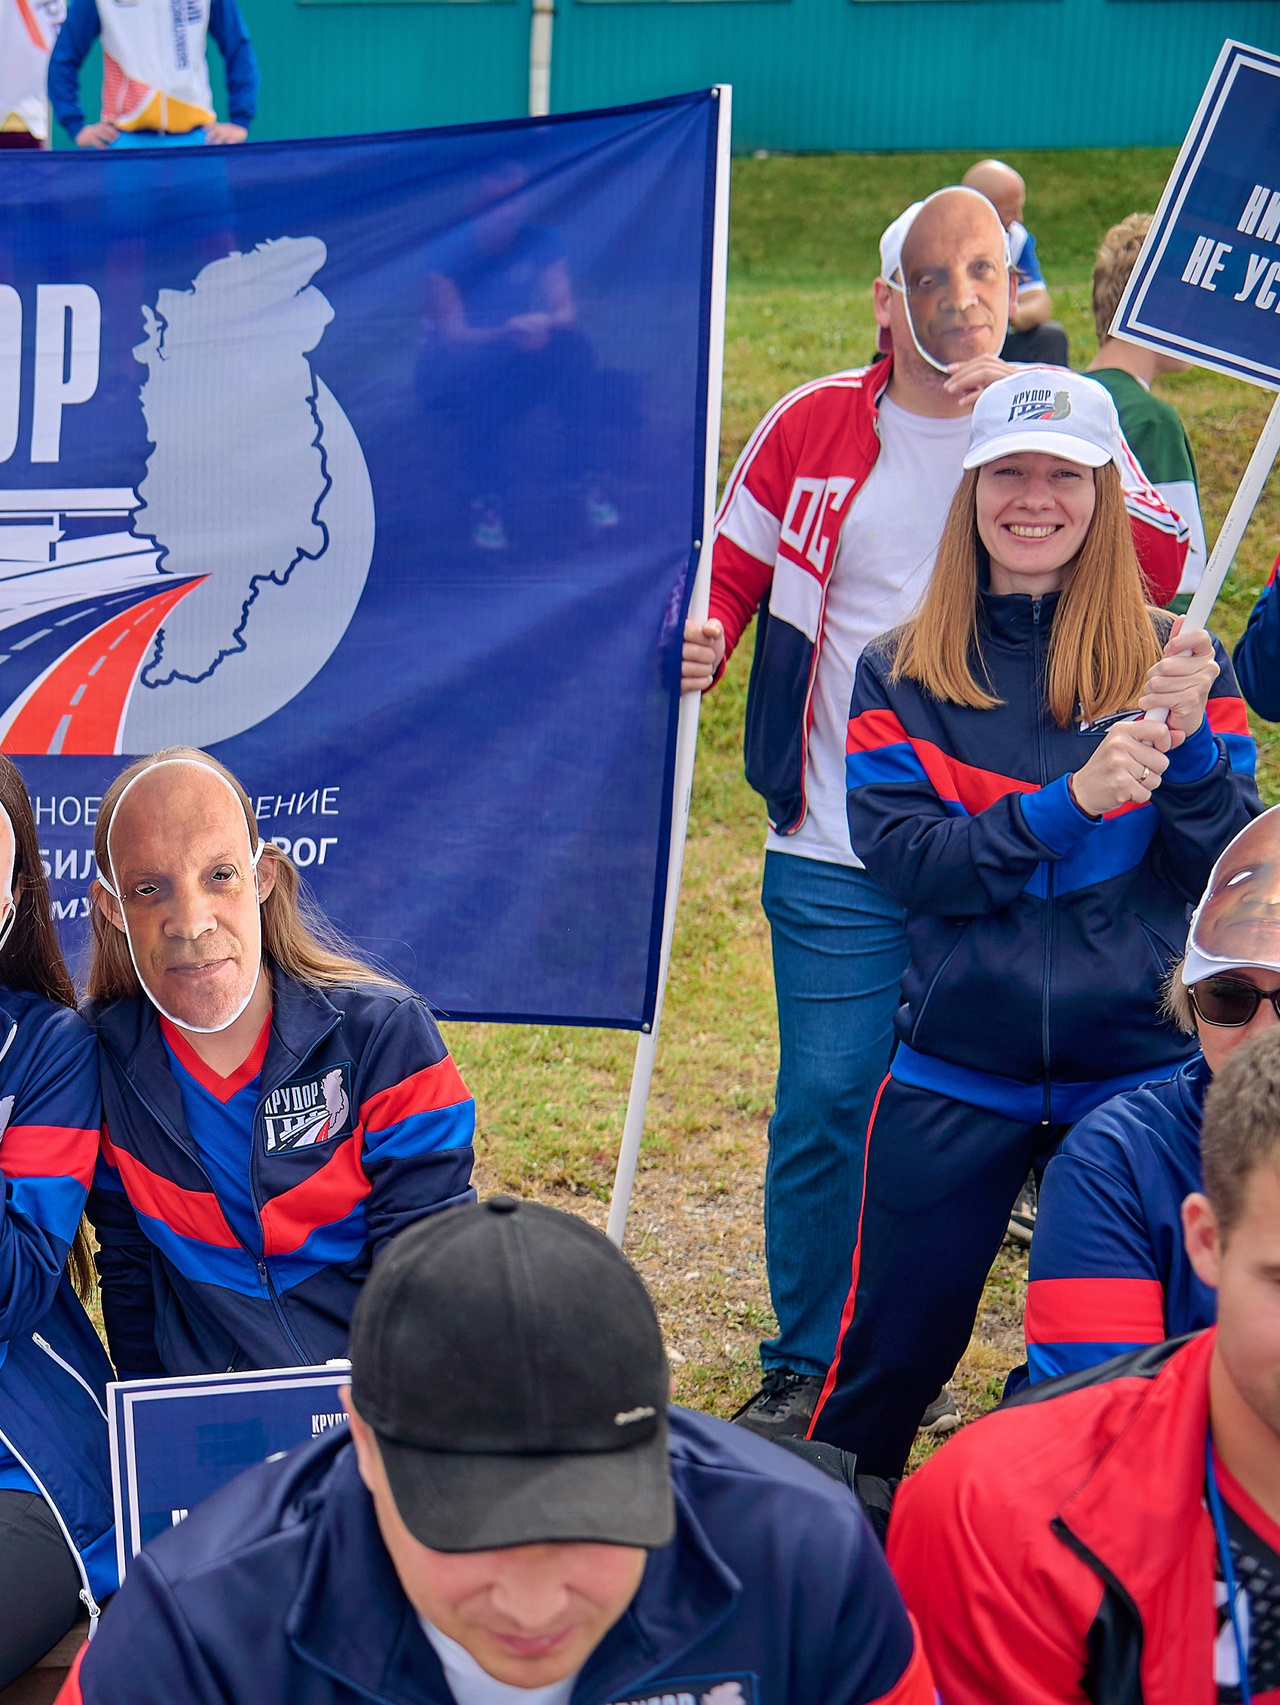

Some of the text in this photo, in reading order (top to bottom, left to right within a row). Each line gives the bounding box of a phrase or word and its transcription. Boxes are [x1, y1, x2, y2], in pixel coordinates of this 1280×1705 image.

[1237, 184, 1280, 245] НИ
[1181, 235, 1280, 314] НЕ УС
[1012, 389, 1051, 405] КРУДОР
